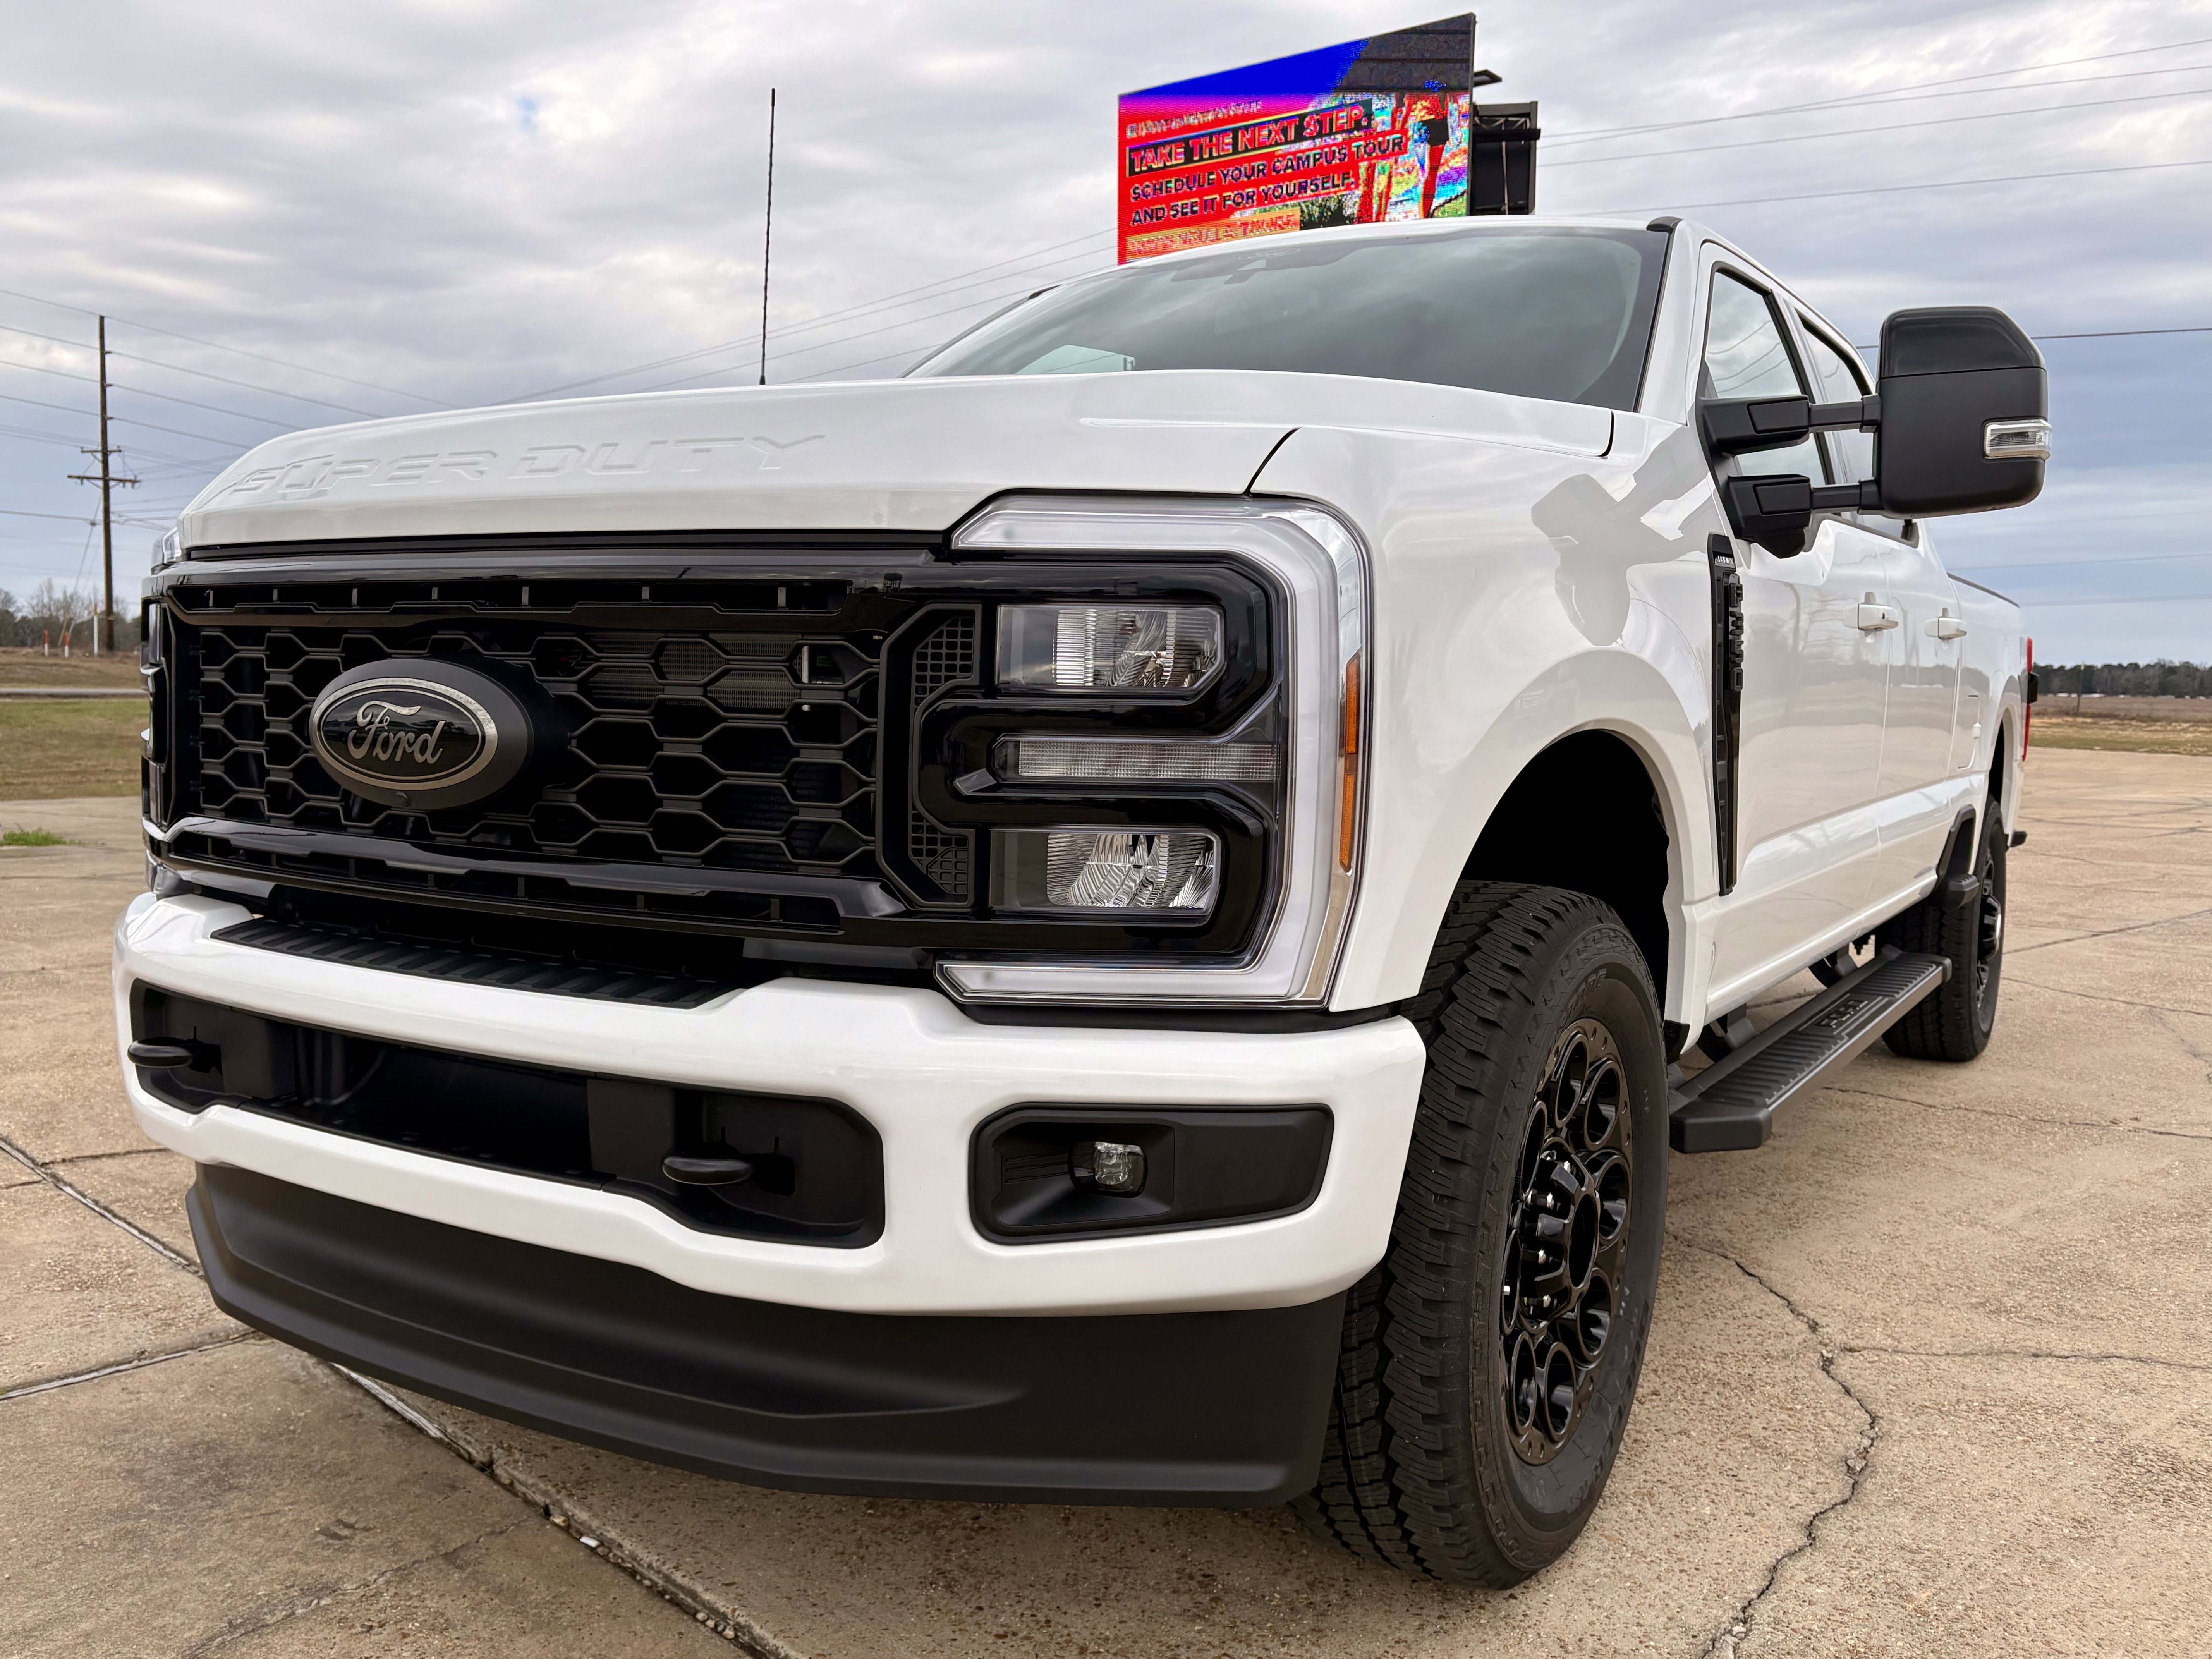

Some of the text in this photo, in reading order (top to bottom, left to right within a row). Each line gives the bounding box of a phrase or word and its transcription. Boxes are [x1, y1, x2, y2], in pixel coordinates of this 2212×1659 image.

[1130, 134, 1404, 201] SCHEDULE YOUR CAMPUS TOUR
[1131, 142, 1185, 172] TAKE
[1190, 132, 1232, 160] THE
[1239, 117, 1298, 151] NEXT
[1304, 105, 1368, 137] STEP.
[1131, 171, 1355, 225] AND SEE IT FOR YOURSELF.
[231, 434, 826, 496] SUPER DUTY
[348, 700, 445, 764] Ford
